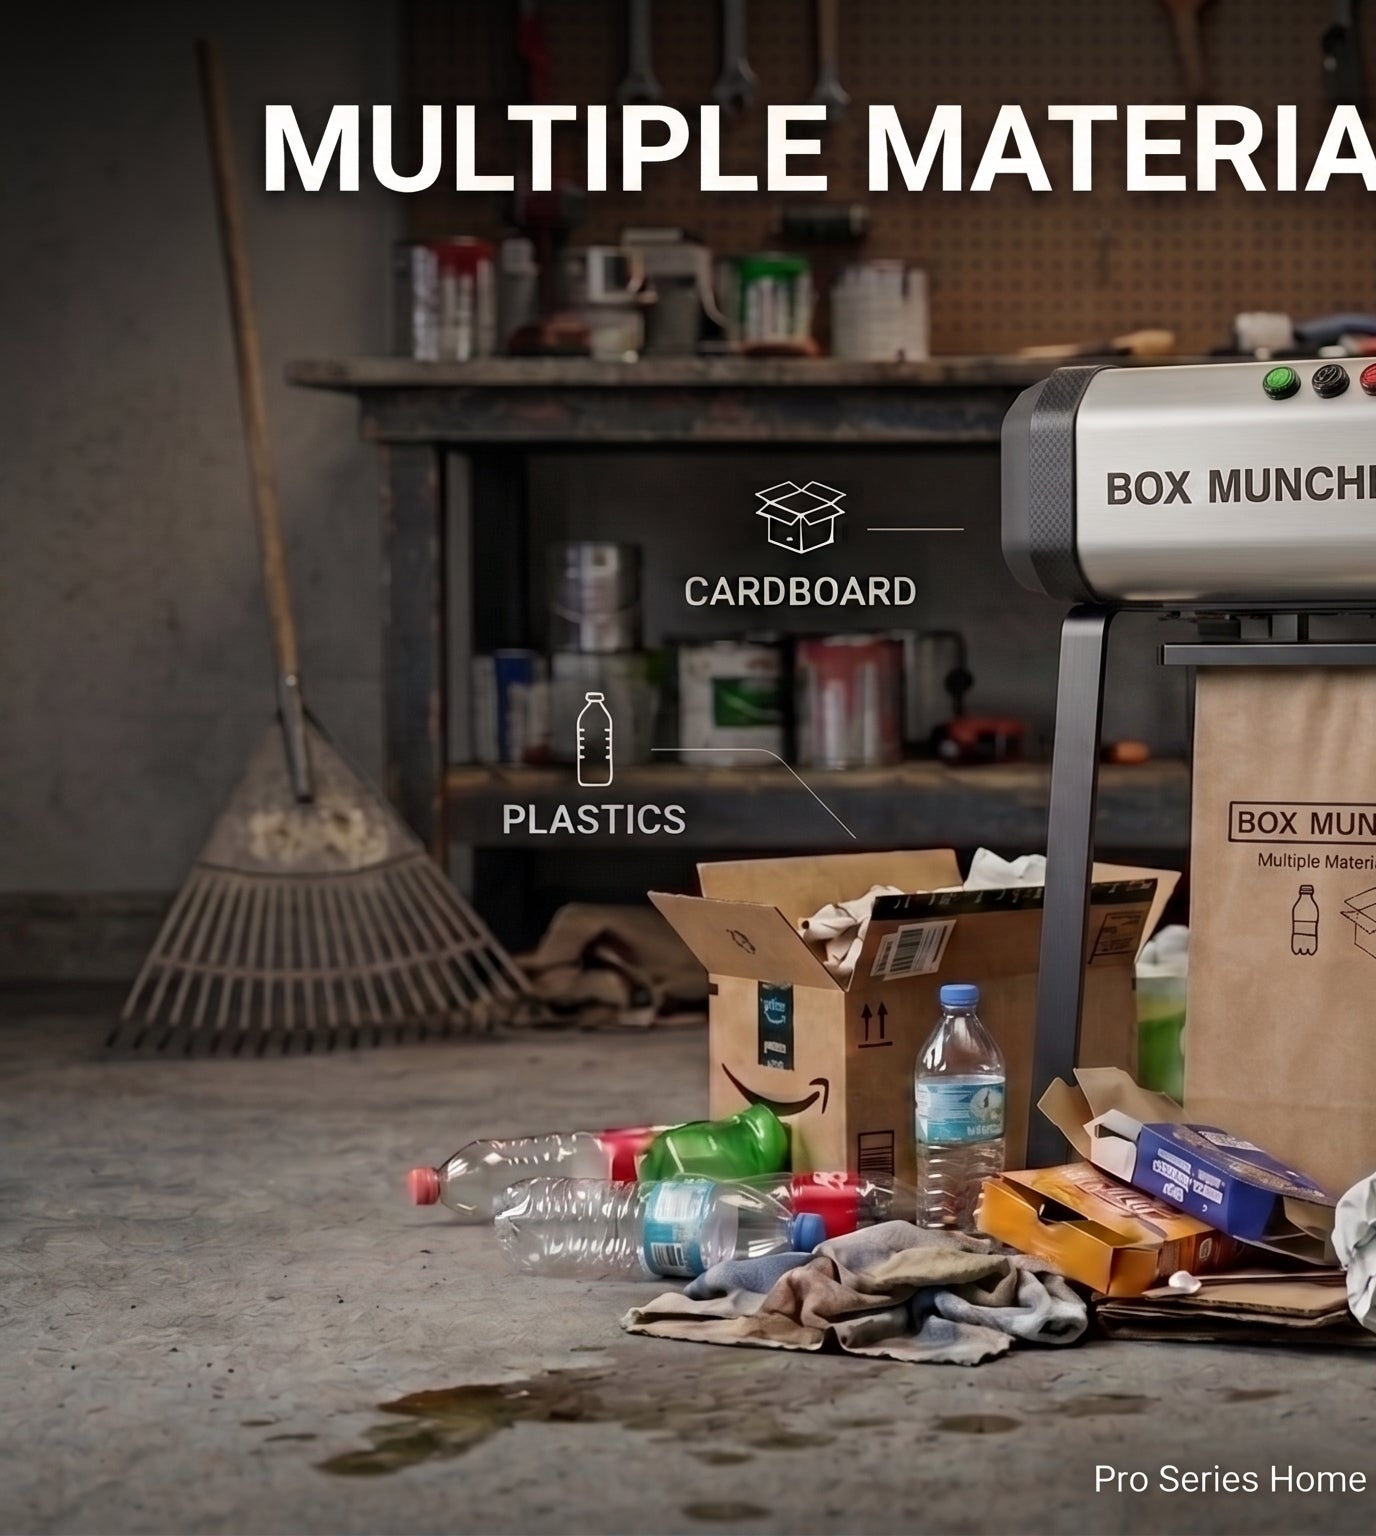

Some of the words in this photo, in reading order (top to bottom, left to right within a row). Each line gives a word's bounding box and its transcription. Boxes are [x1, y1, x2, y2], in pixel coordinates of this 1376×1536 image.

[1105, 469, 1193, 507] BOX
[1237, 810, 1298, 836] BOX
[1257, 852, 1321, 872] Multiple
